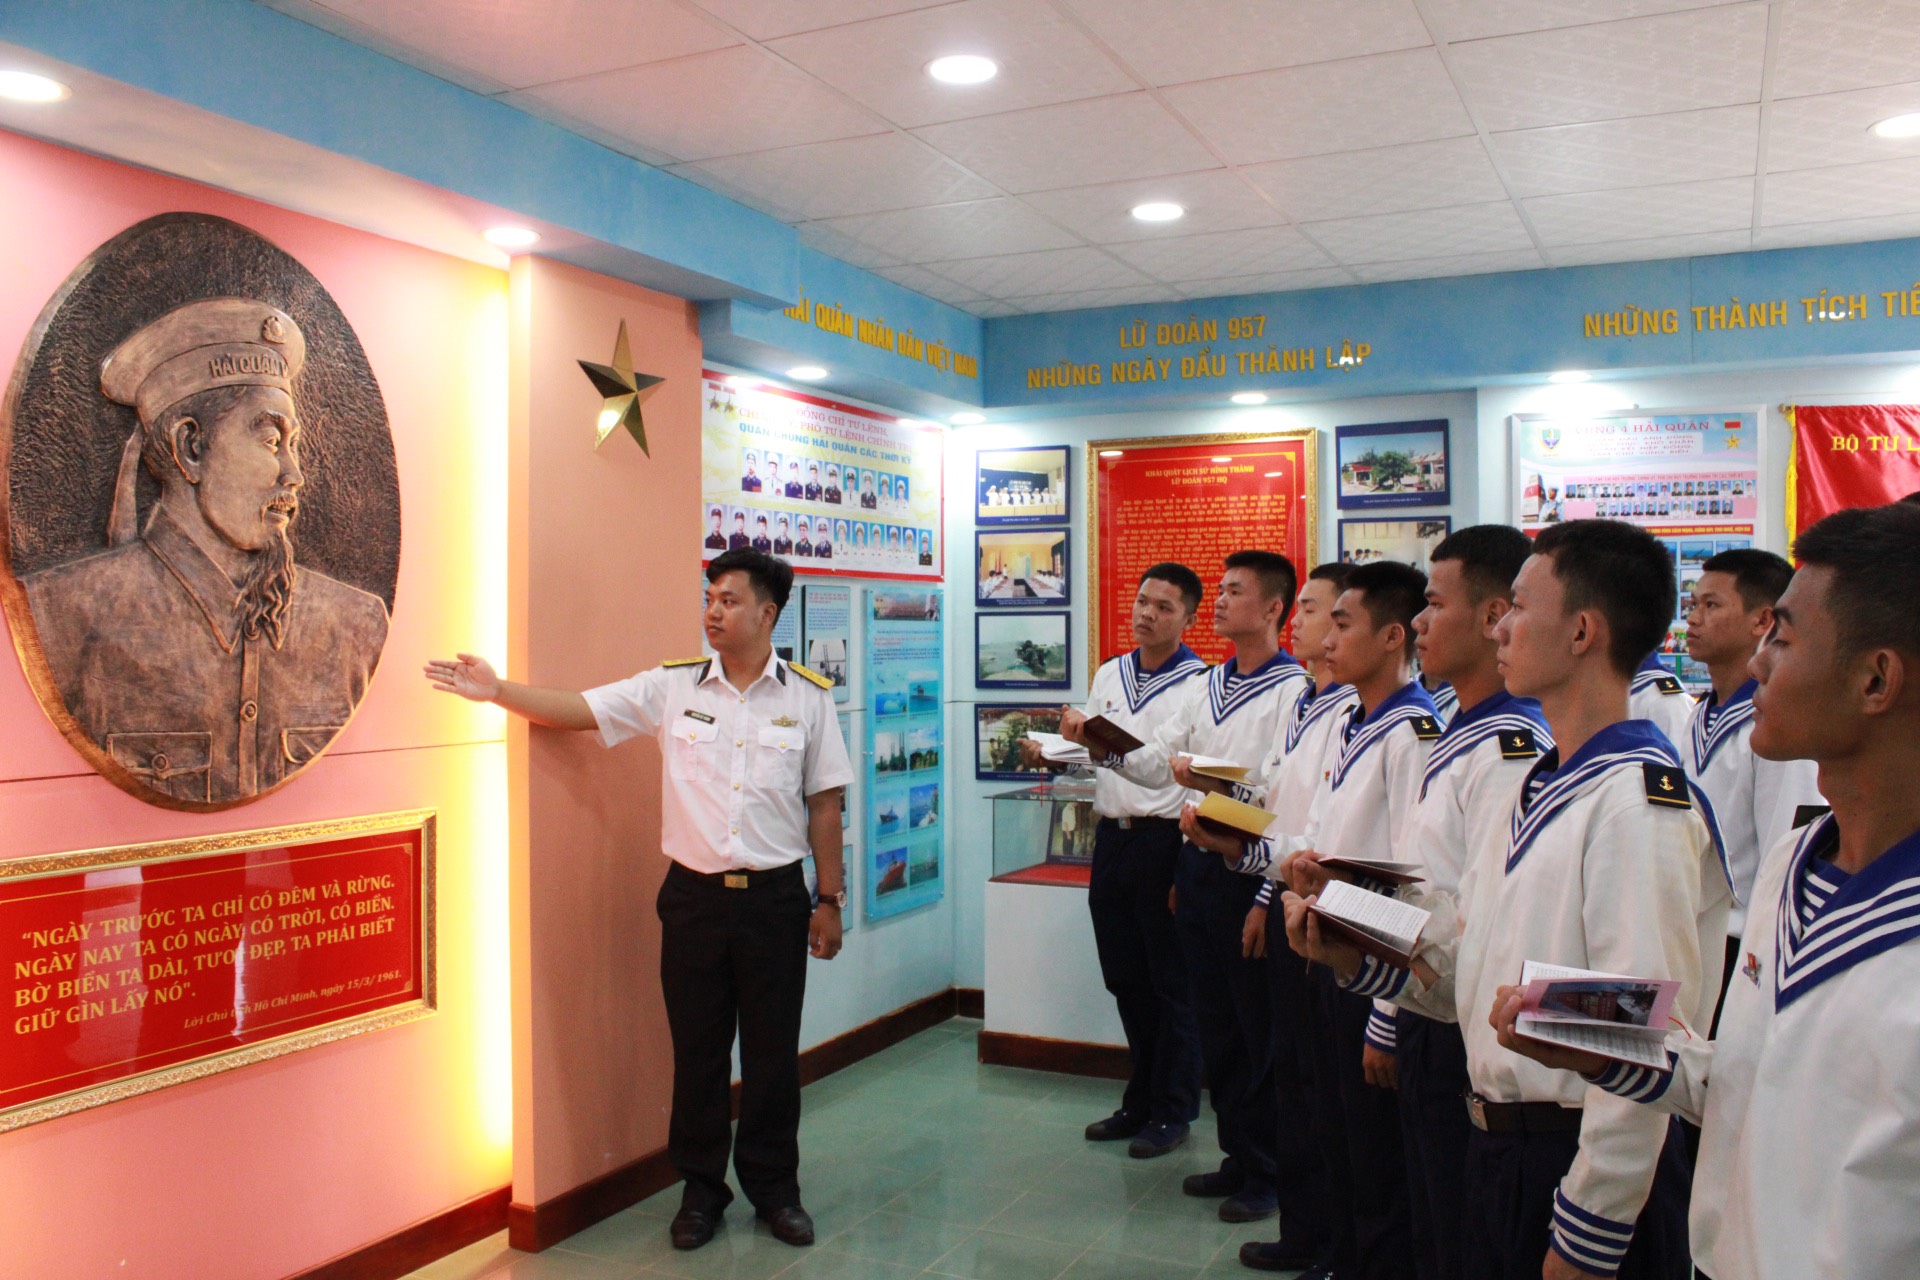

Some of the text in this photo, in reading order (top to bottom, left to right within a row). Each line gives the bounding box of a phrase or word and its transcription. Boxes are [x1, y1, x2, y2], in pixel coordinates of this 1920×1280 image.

[1119, 314, 1266, 348] LỮ ĐOÀN 957
[1583, 304, 1679, 338] NHỮNG
[1690, 297, 1788, 332] THÀNH
[1801, 288, 1868, 323] TÍCH
[815, 302, 854, 338] QUÂN
[857, 317, 894, 352] NHÂN
[897, 328, 923, 361] DÂN
[925, 339, 952, 374] VIỆT
[953, 352, 977, 379] NAM
[1027, 338, 1372, 389] NHỮNG NGÀY ĐẦU THÀNH LẬP
[209, 352, 237, 378] HẢI
[240, 353, 280, 376] QUÂN
[812, 435, 829, 449] HẢI
[831, 440, 858, 456] QUÂN
[859, 446, 878, 459] CÁC
[1633, 420, 1660, 432] HẢI
[1664, 420, 1710, 432] QUÂN
[1830, 433, 1860, 454] BỘ
[1866, 434, 1900, 452] TƯ
[1202, 476, 1215, 484] 957
[101, 908, 176, 937] TRƯỚC
[181, 905, 206, 923] TA
[211, 894, 244, 918] CHỈ
[250, 891, 273, 911] CÓ
[278, 885, 316, 907] ĐÊM
[321, 879, 342, 899] VÀ
[346, 874, 395, 895] RỪNG.
[14, 951, 77, 980] NGÀY
[83, 943, 125, 967] NAY
[131, 938, 157, 958] TA
[162, 929, 189, 952] CÓ
[251, 915, 274, 936] CÓ
[278, 908, 326, 931] TRỜI,
[330, 903, 351, 921] CÓ
[355, 894, 395, 916] BIỂN.
[15, 981, 52, 1008] BỜ
[57, 969, 111, 999] BIỂN
[116, 967, 143, 987] TA
[148, 957, 189, 981] DÀI,
[249, 939, 287, 962] ĐẸP,
[291, 934, 312, 951] TA
[316, 924, 356, 947] PHẢI
[359, 915, 396, 938] BIẾT
[14, 1008, 61, 1035] GIỮ
[65, 1000, 105, 1024] GÌN
[110, 988, 150, 1015] LẤY
[184, 1015, 205, 1029] Lời
[206, 1008, 228, 1023] Chủ
[254, 1000, 269, 1012] Hồ
[271, 995, 289, 1008] Chí
[290, 989, 319, 1004] Minh,
[320, 983, 346, 997] ngày
